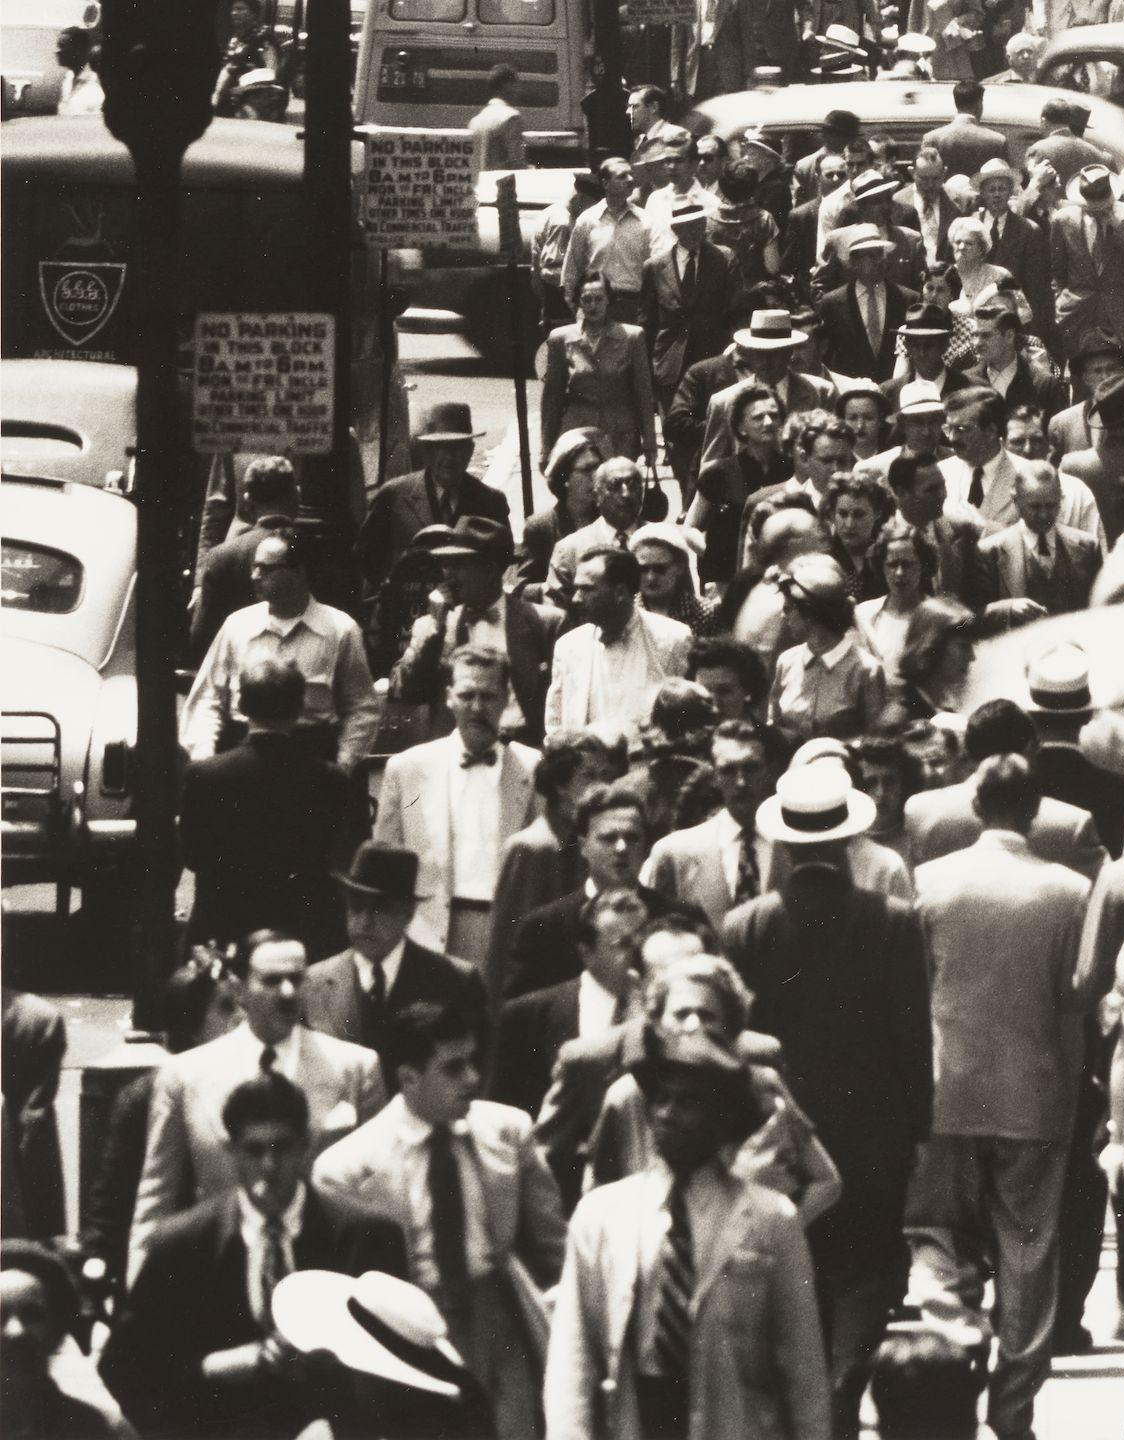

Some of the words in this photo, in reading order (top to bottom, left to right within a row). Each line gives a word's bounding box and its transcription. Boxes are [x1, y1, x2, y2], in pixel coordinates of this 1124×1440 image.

[371, 141, 395, 154] NO
[401, 140, 474, 155] PARKING
[373, 157, 386, 168] IN
[391, 156, 422, 168] THIS
[427, 156, 470, 168] BLOCK
[378, 197, 426, 208] PARKING
[201, 322, 231, 338] NO
[237, 321, 327, 339] PARKING
[33, 348, 116, 361] ARCHITECTURAL
[203, 341, 220, 354] IN
[227, 340, 264, 355] THIS
[270, 341, 324, 355] BLOCK
